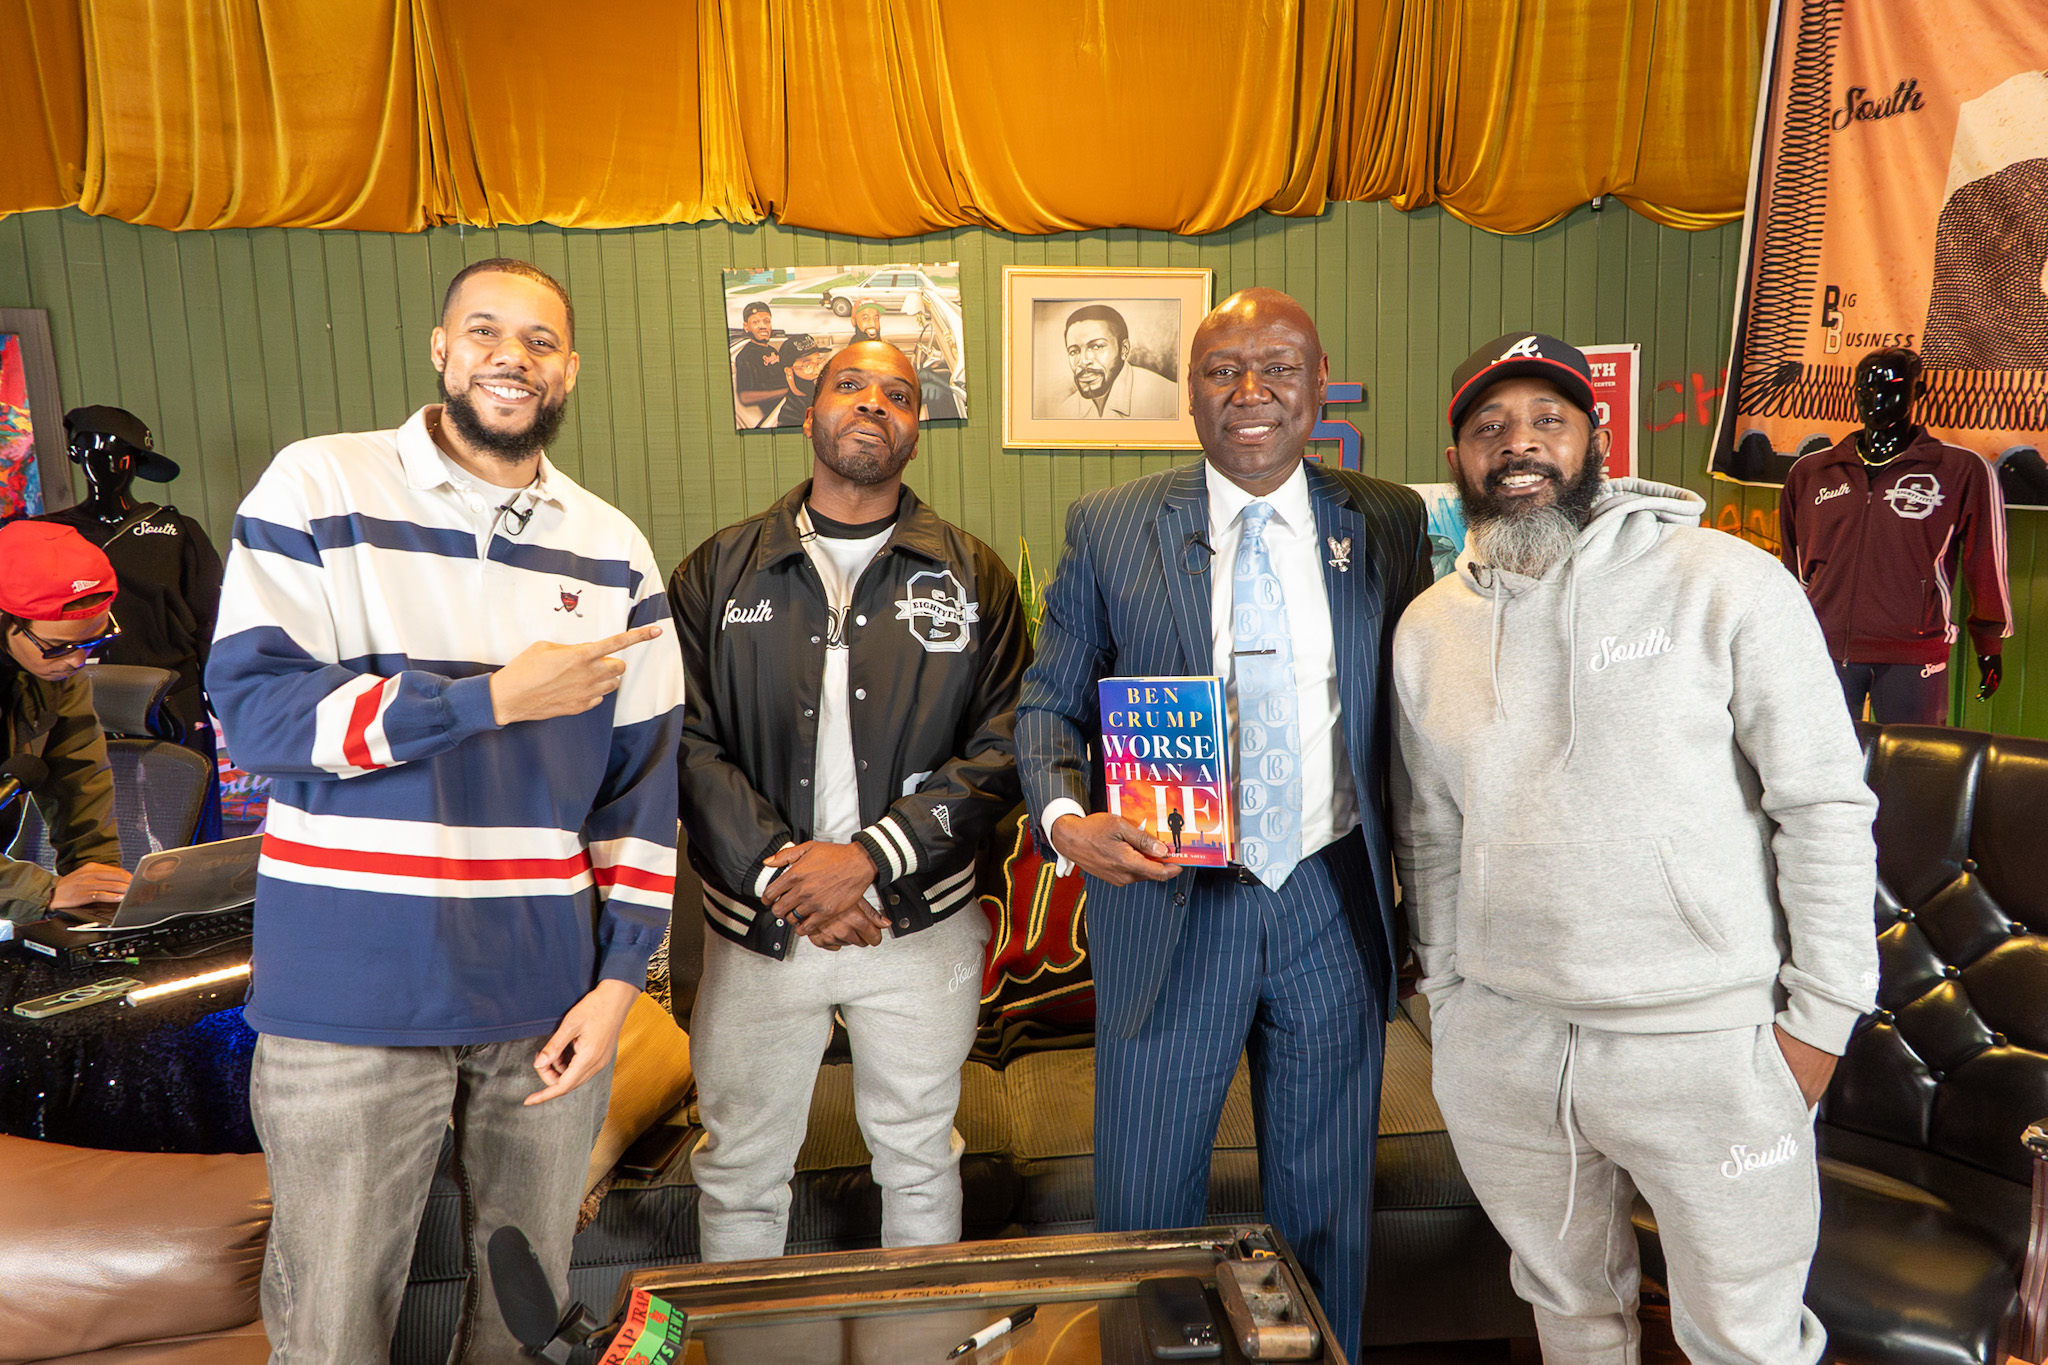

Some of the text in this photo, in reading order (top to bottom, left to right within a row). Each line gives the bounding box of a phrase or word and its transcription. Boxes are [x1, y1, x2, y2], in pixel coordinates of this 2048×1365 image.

[1832, 78, 1925, 131] South
[1491, 335, 1543, 365] A
[1589, 362, 1617, 377] TH
[1815, 482, 1851, 505] South
[133, 521, 178, 536] South
[722, 599, 773, 631] South
[1589, 626, 1675, 672] South
[1127, 687, 1179, 704] BEN
[1108, 711, 1203, 728] CRUMP
[1102, 734, 1215, 760] WORSE
[1106, 762, 1214, 783] THAN A
[1106, 783, 1223, 835] LIE
[1720, 1132, 1799, 1178] South
[631, 1291, 650, 1325] TRAP
[667, 1307, 684, 1345] NEWS
[604, 1328, 637, 1365] RAP
